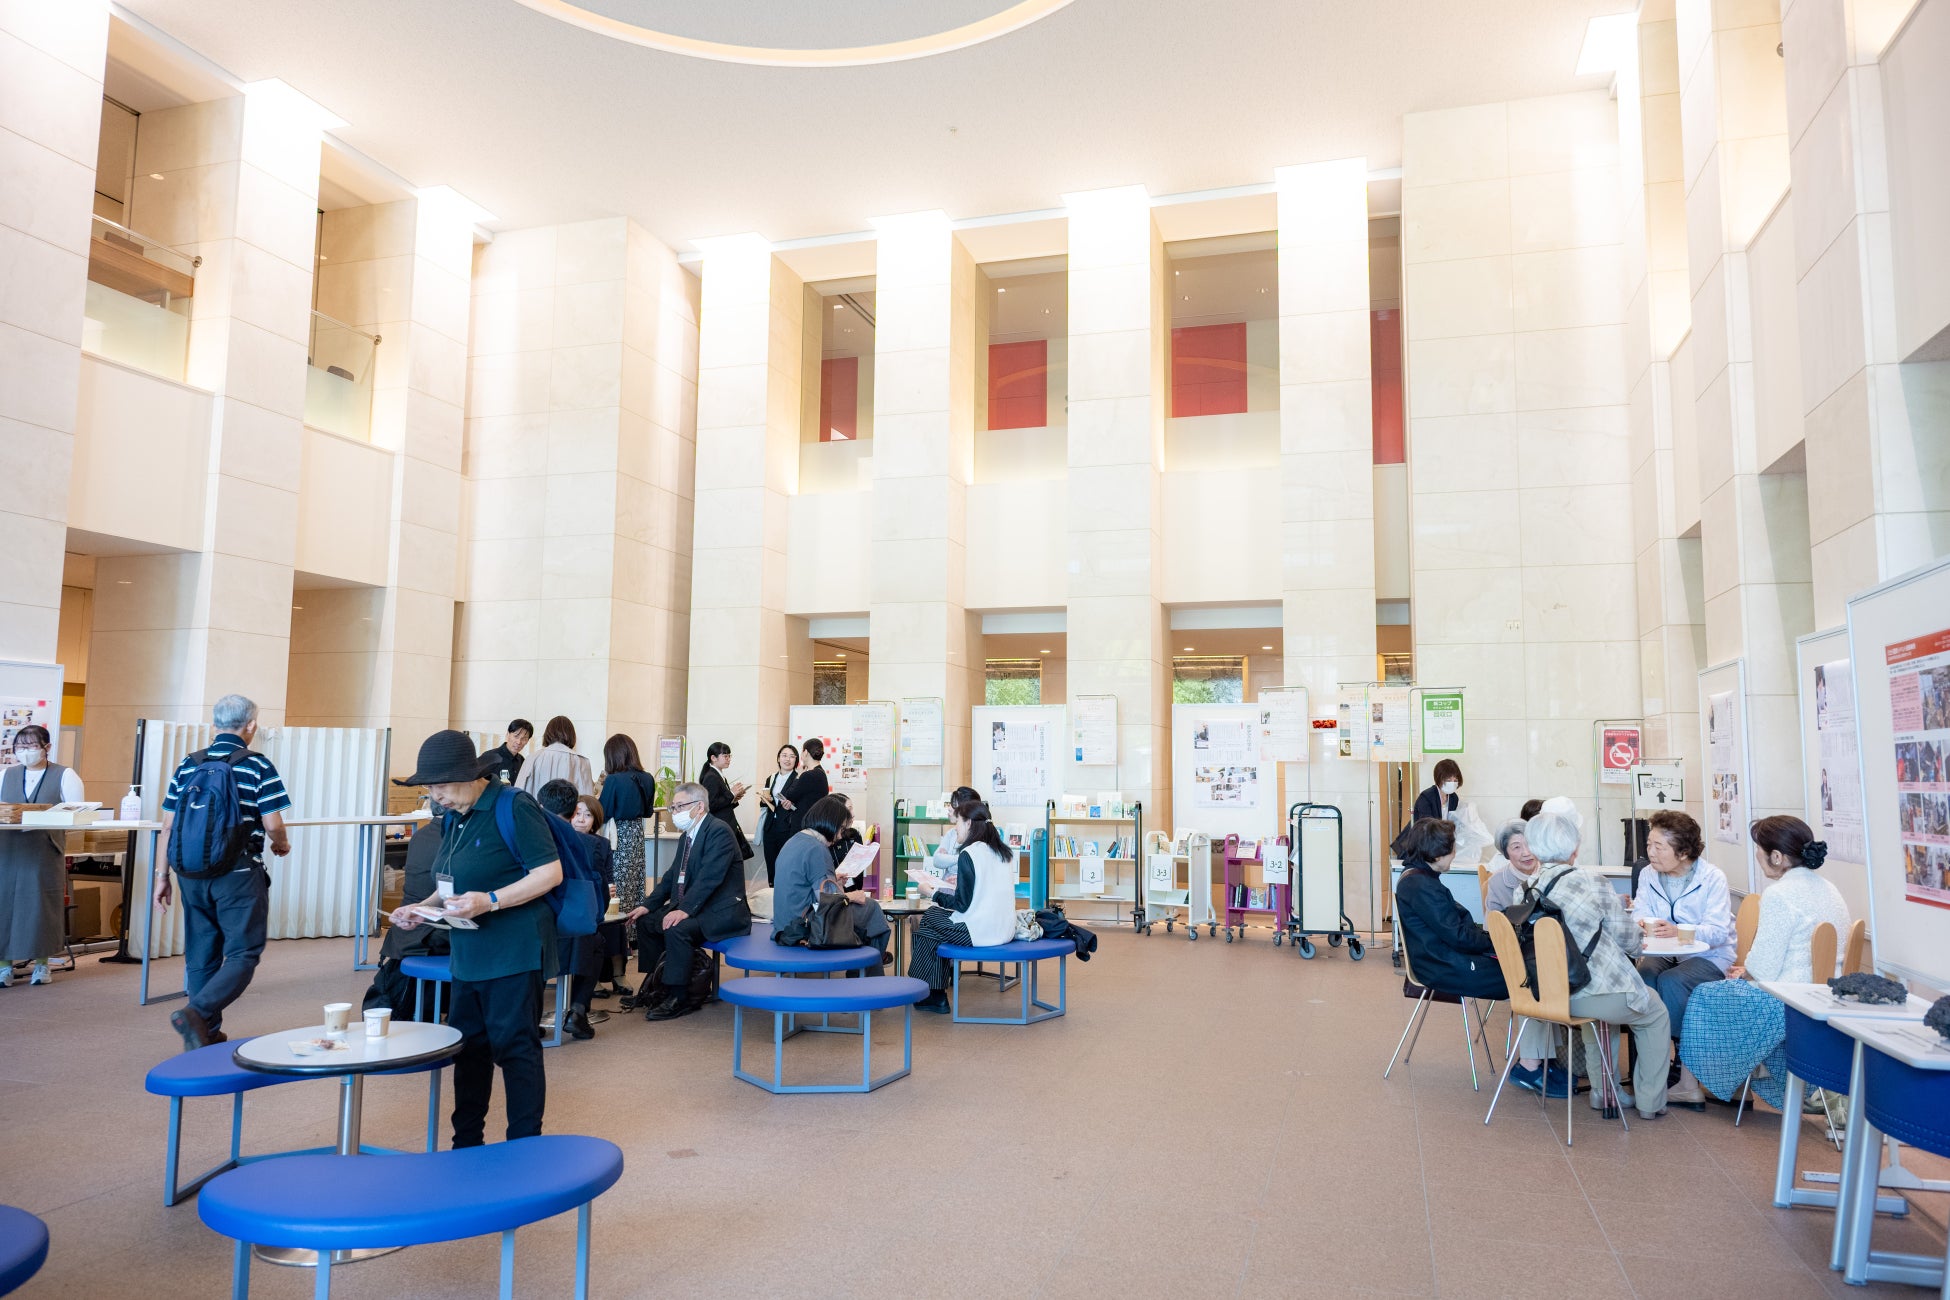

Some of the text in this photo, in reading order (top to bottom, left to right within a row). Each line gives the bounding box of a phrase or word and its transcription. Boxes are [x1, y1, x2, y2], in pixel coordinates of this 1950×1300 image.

[1643, 781, 1680, 790] 絵本コーナー
[1156, 868, 1168, 877] 3-3
